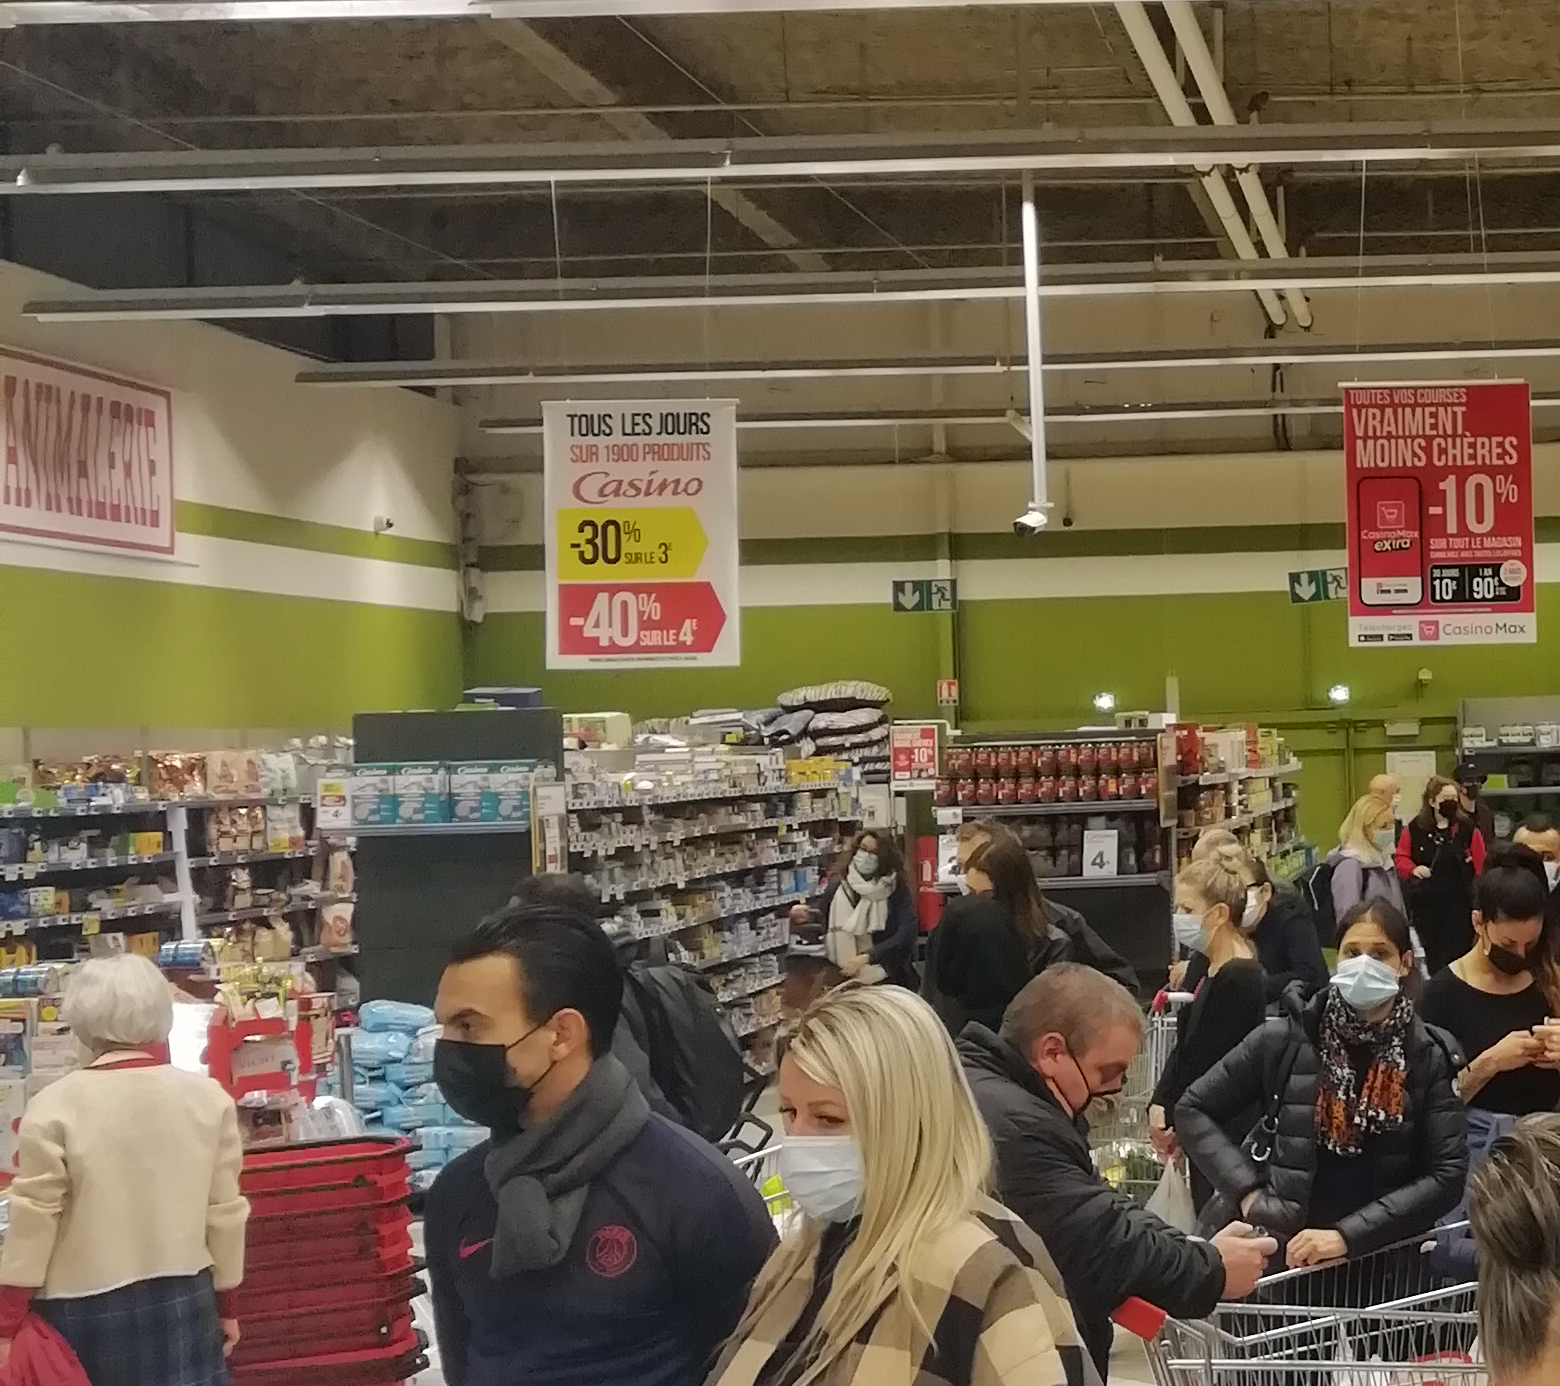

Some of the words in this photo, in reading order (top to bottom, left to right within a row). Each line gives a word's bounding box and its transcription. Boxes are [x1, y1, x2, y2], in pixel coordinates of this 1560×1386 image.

[1350, 389, 1390, 404] TOUTES
[1393, 389, 1415, 404] VOS
[1417, 388, 1468, 403] COURSES
[566, 413, 613, 437] TOUS
[621, 413, 653, 437] LES
[656, 412, 711, 436] JOURS
[1352, 406, 1467, 437] VRAIMENT
[4, 375, 160, 528] ANIMALERIE
[569, 444, 599, 463] SUR
[605, 444, 639, 463] 1900
[642, 442, 711, 462] PRODUITS
[1356, 439, 1427, 468] MOINS
[1433, 432, 1518, 467] CHÈRES
[572, 470, 704, 504] Casino
[1430, 538, 1447, 549] SUR
[1448, 538, 1470, 549] TOUT
[1471, 537, 1482, 548] LE
[645, 551, 656, 564] LE
[639, 630, 663, 646] SUR
[663, 629, 677, 645] LE
